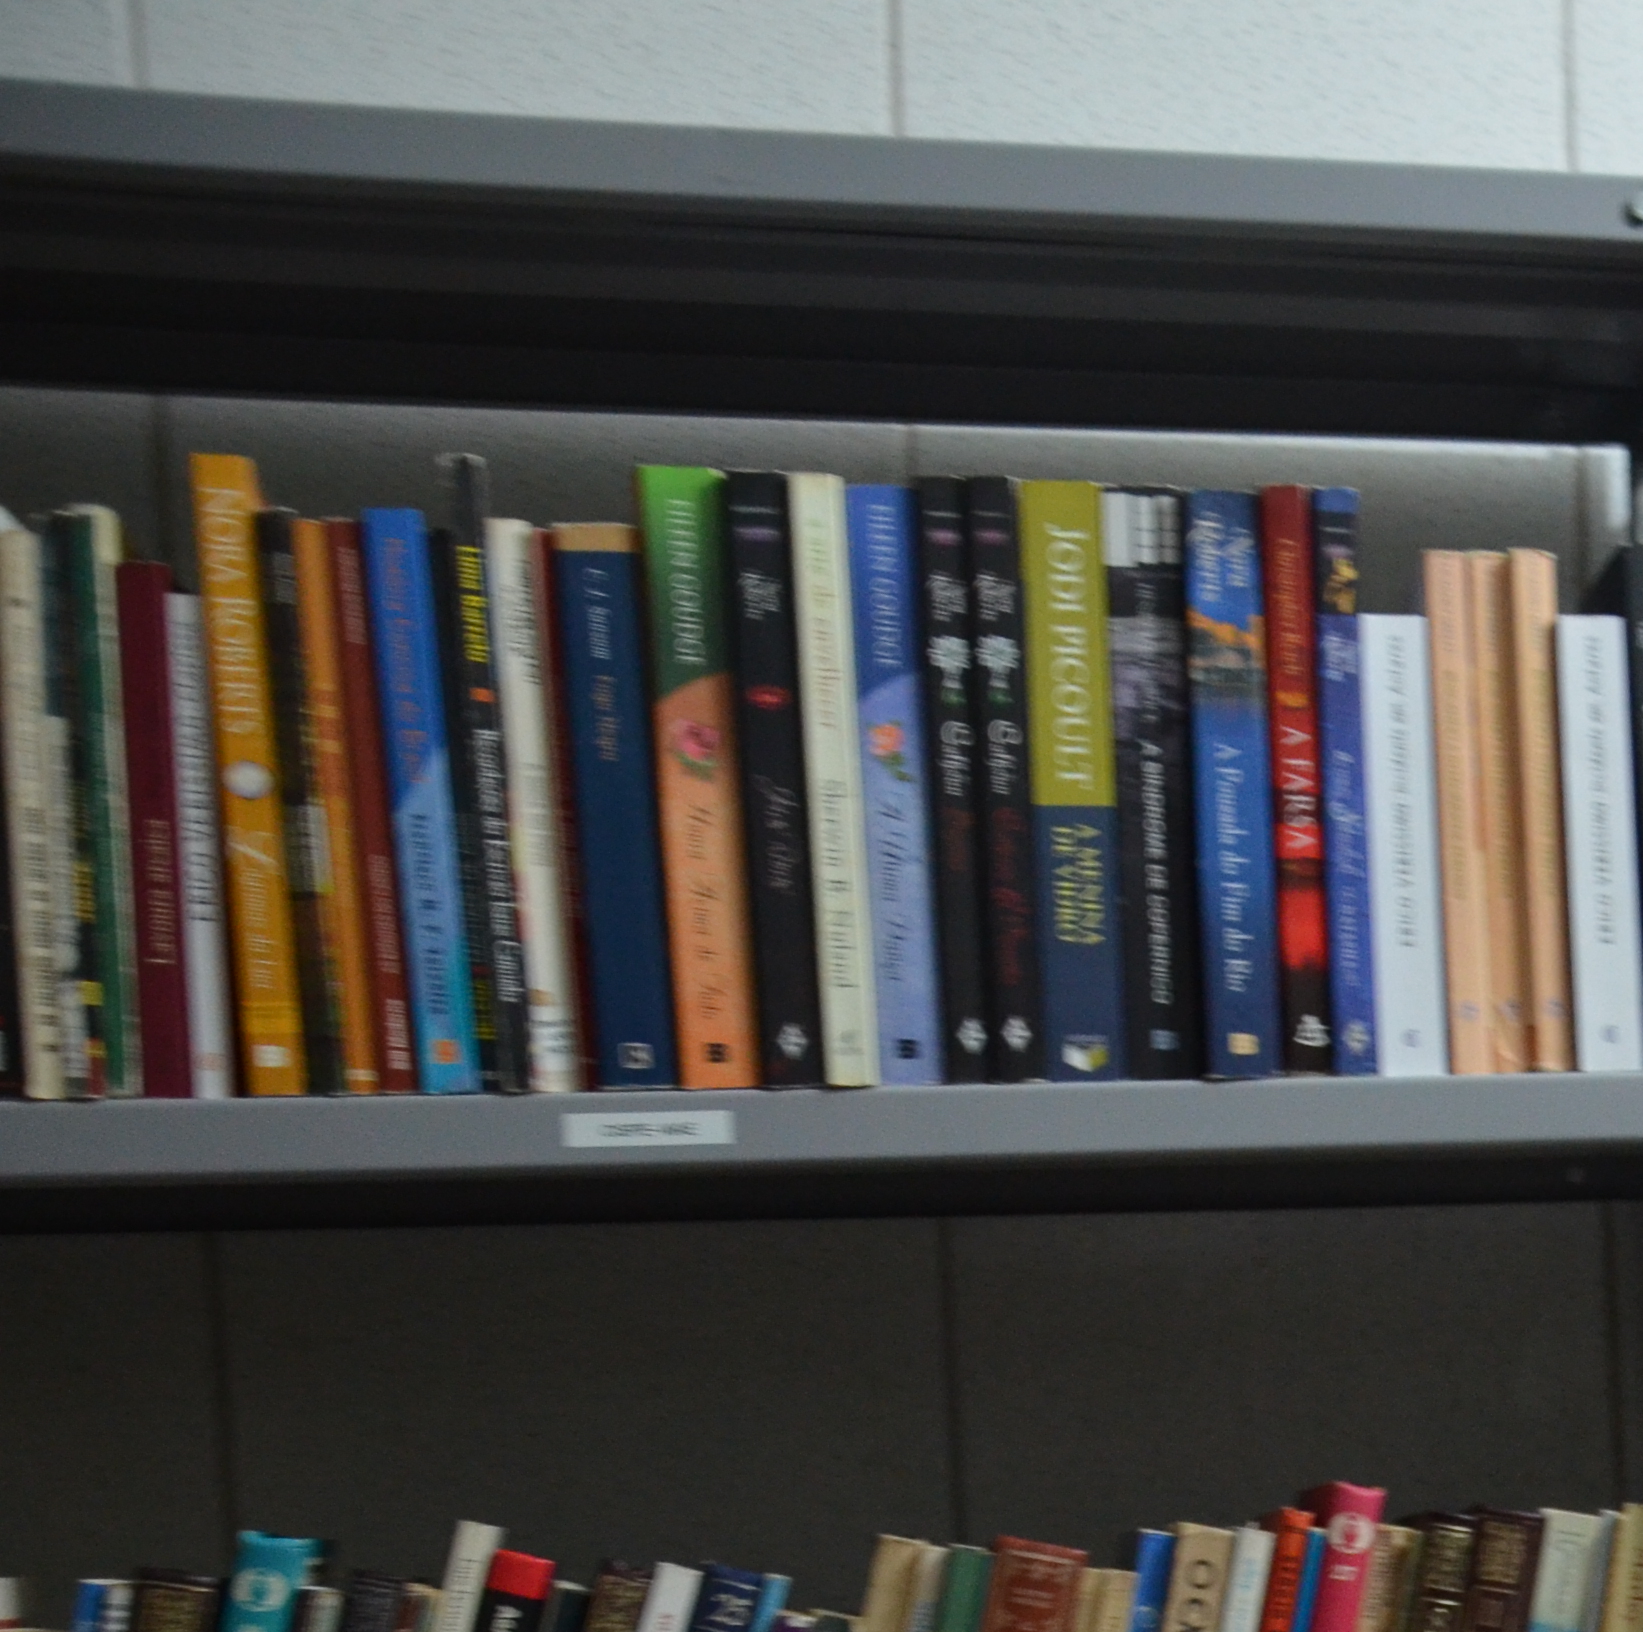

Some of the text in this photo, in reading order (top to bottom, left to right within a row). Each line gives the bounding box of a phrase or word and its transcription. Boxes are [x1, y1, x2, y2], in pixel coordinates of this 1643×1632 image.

[201, 489, 261, 736] NORA ROBERTS
[454, 546, 490, 663] Lima Barreto
[1041, 521, 1095, 791] JODI PICOULT
[1282, 725, 1319, 851] A FARSA
[1082, 844, 1106, 945] MENINA
[1220, 847, 1247, 875] do
[1224, 925, 1250, 950] do
[1225, 956, 1252, 991] Rio
[1187, 1559, 1217, 1589] O
